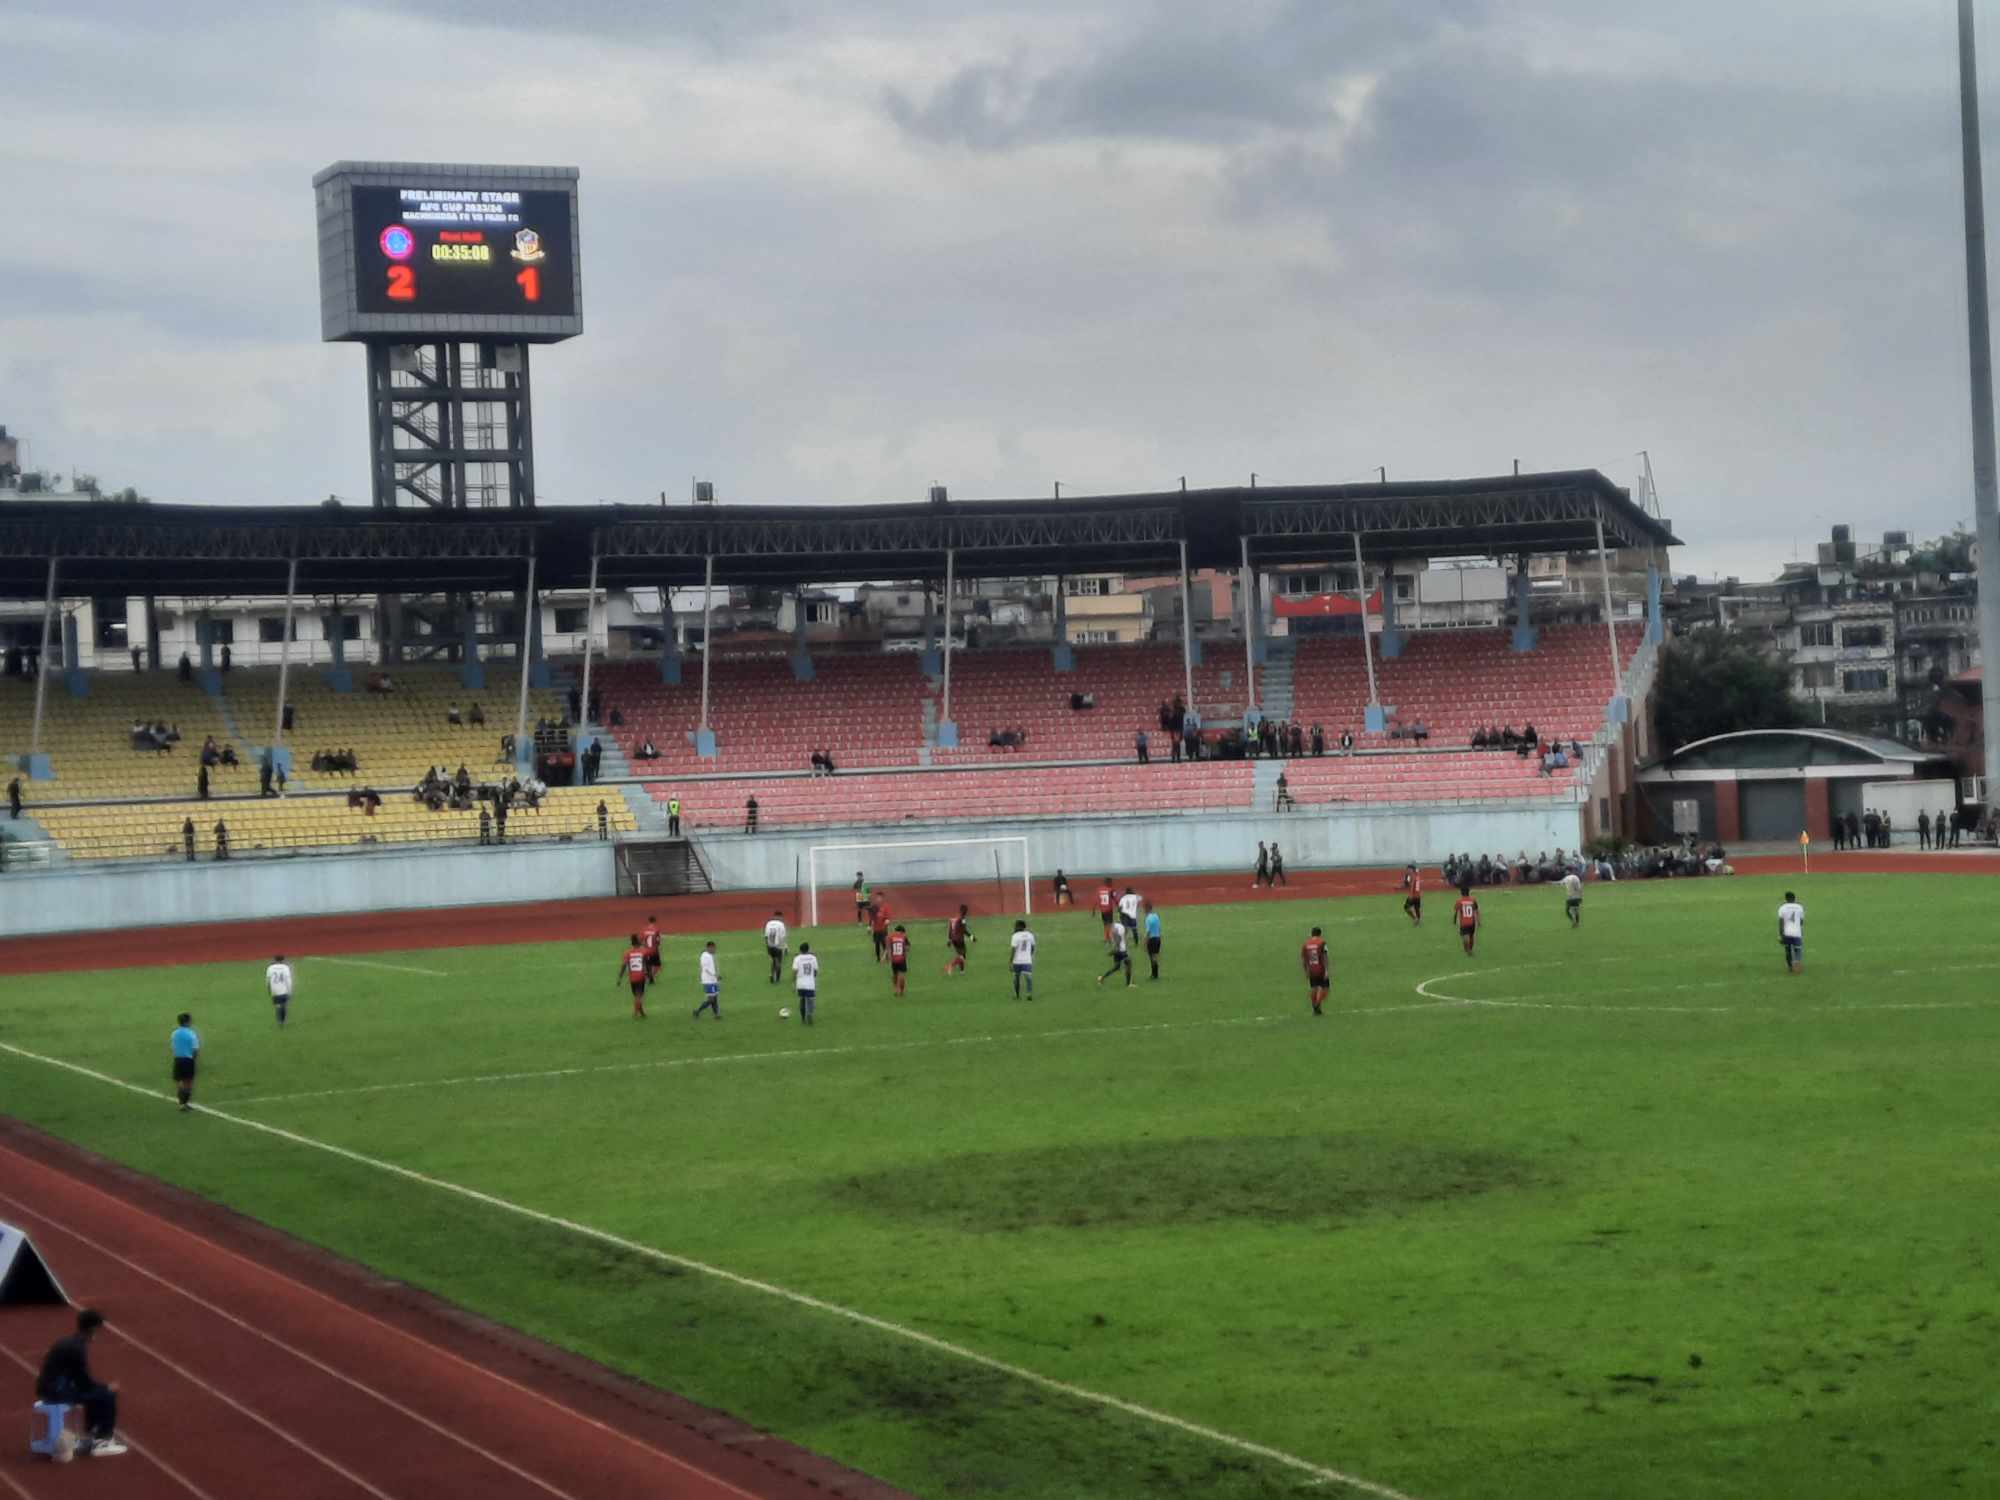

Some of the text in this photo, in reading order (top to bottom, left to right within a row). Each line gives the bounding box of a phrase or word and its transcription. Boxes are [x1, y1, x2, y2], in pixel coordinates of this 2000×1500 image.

[400, 190, 520, 203] PRELIMINARY STAGE
[442, 203, 463, 212] CUP
[432, 245, 489, 260] 00:35:00
[386, 265, 539, 301] 2 1
